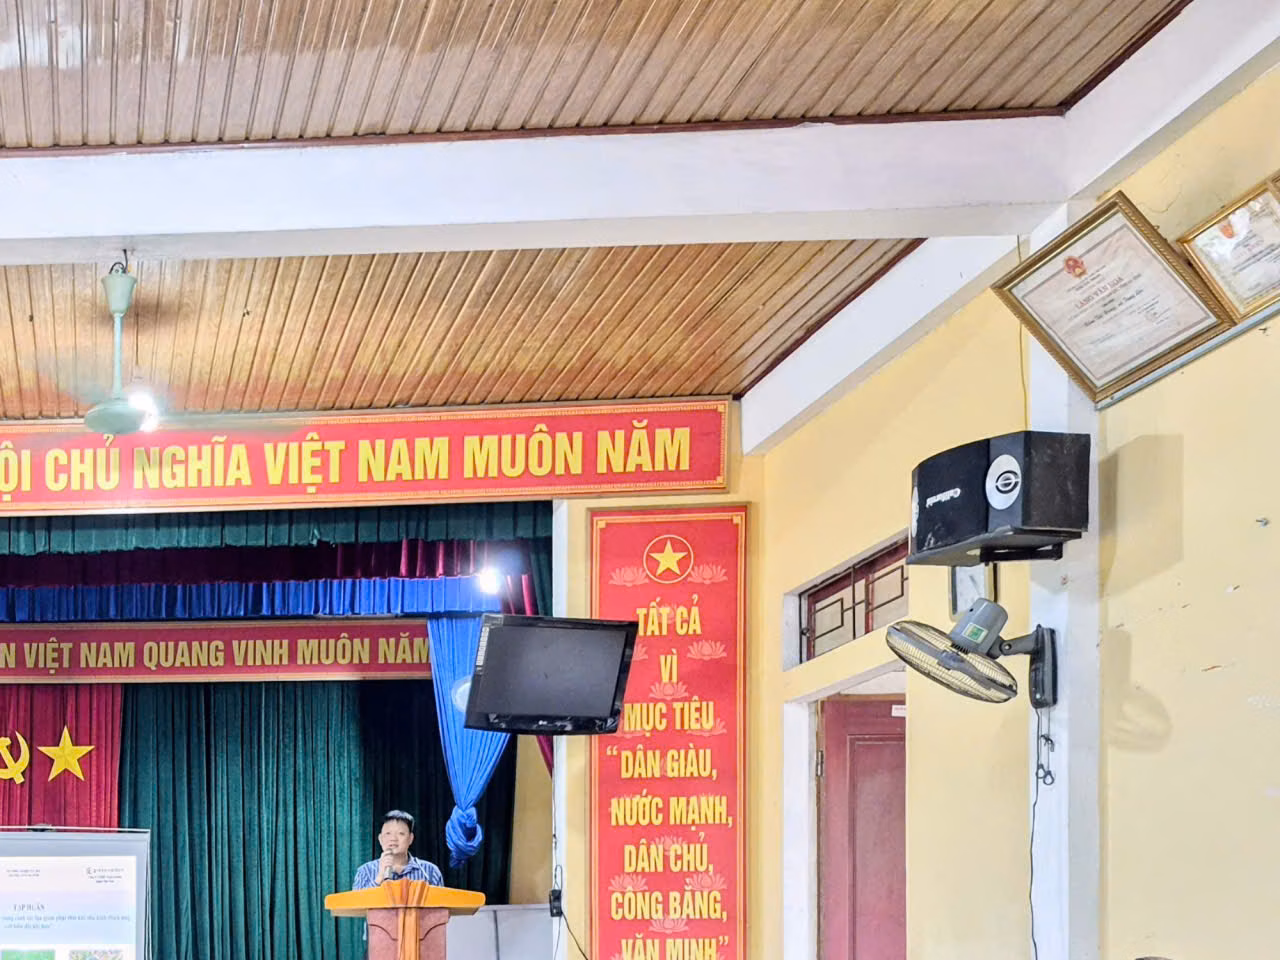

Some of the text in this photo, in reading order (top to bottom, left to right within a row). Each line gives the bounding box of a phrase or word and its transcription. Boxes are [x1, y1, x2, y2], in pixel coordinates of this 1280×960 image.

[45, 434, 120, 491] CHỦ
[133, 435, 252, 489] NGHĨA
[264, 432, 346, 494] VIỆT
[358, 436, 450, 483] NAM
[463, 423, 584, 479] MUÔN
[596, 420, 691, 474] NĂM
[636, 594, 702, 636] TẤT CẢ
[23, 637, 73, 674] VIỆT
[80, 641, 136, 668] NAM
[143, 640, 225, 671] QUANG
[232, 639, 289, 666] VINH
[296, 632, 370, 665] MUÔN
[378, 632, 432, 664] NĂM
[660, 648, 678, 683] VÌ
[623, 696, 714, 737] MỤC TIÊU
[666, 743, 718, 780] GIÀU,
[610, 789, 733, 831] NƯỚC MẠNH,
[624, 832, 714, 875] DÂN CHỦ,
[610, 878, 728, 922] CÔNG BẰNG,
